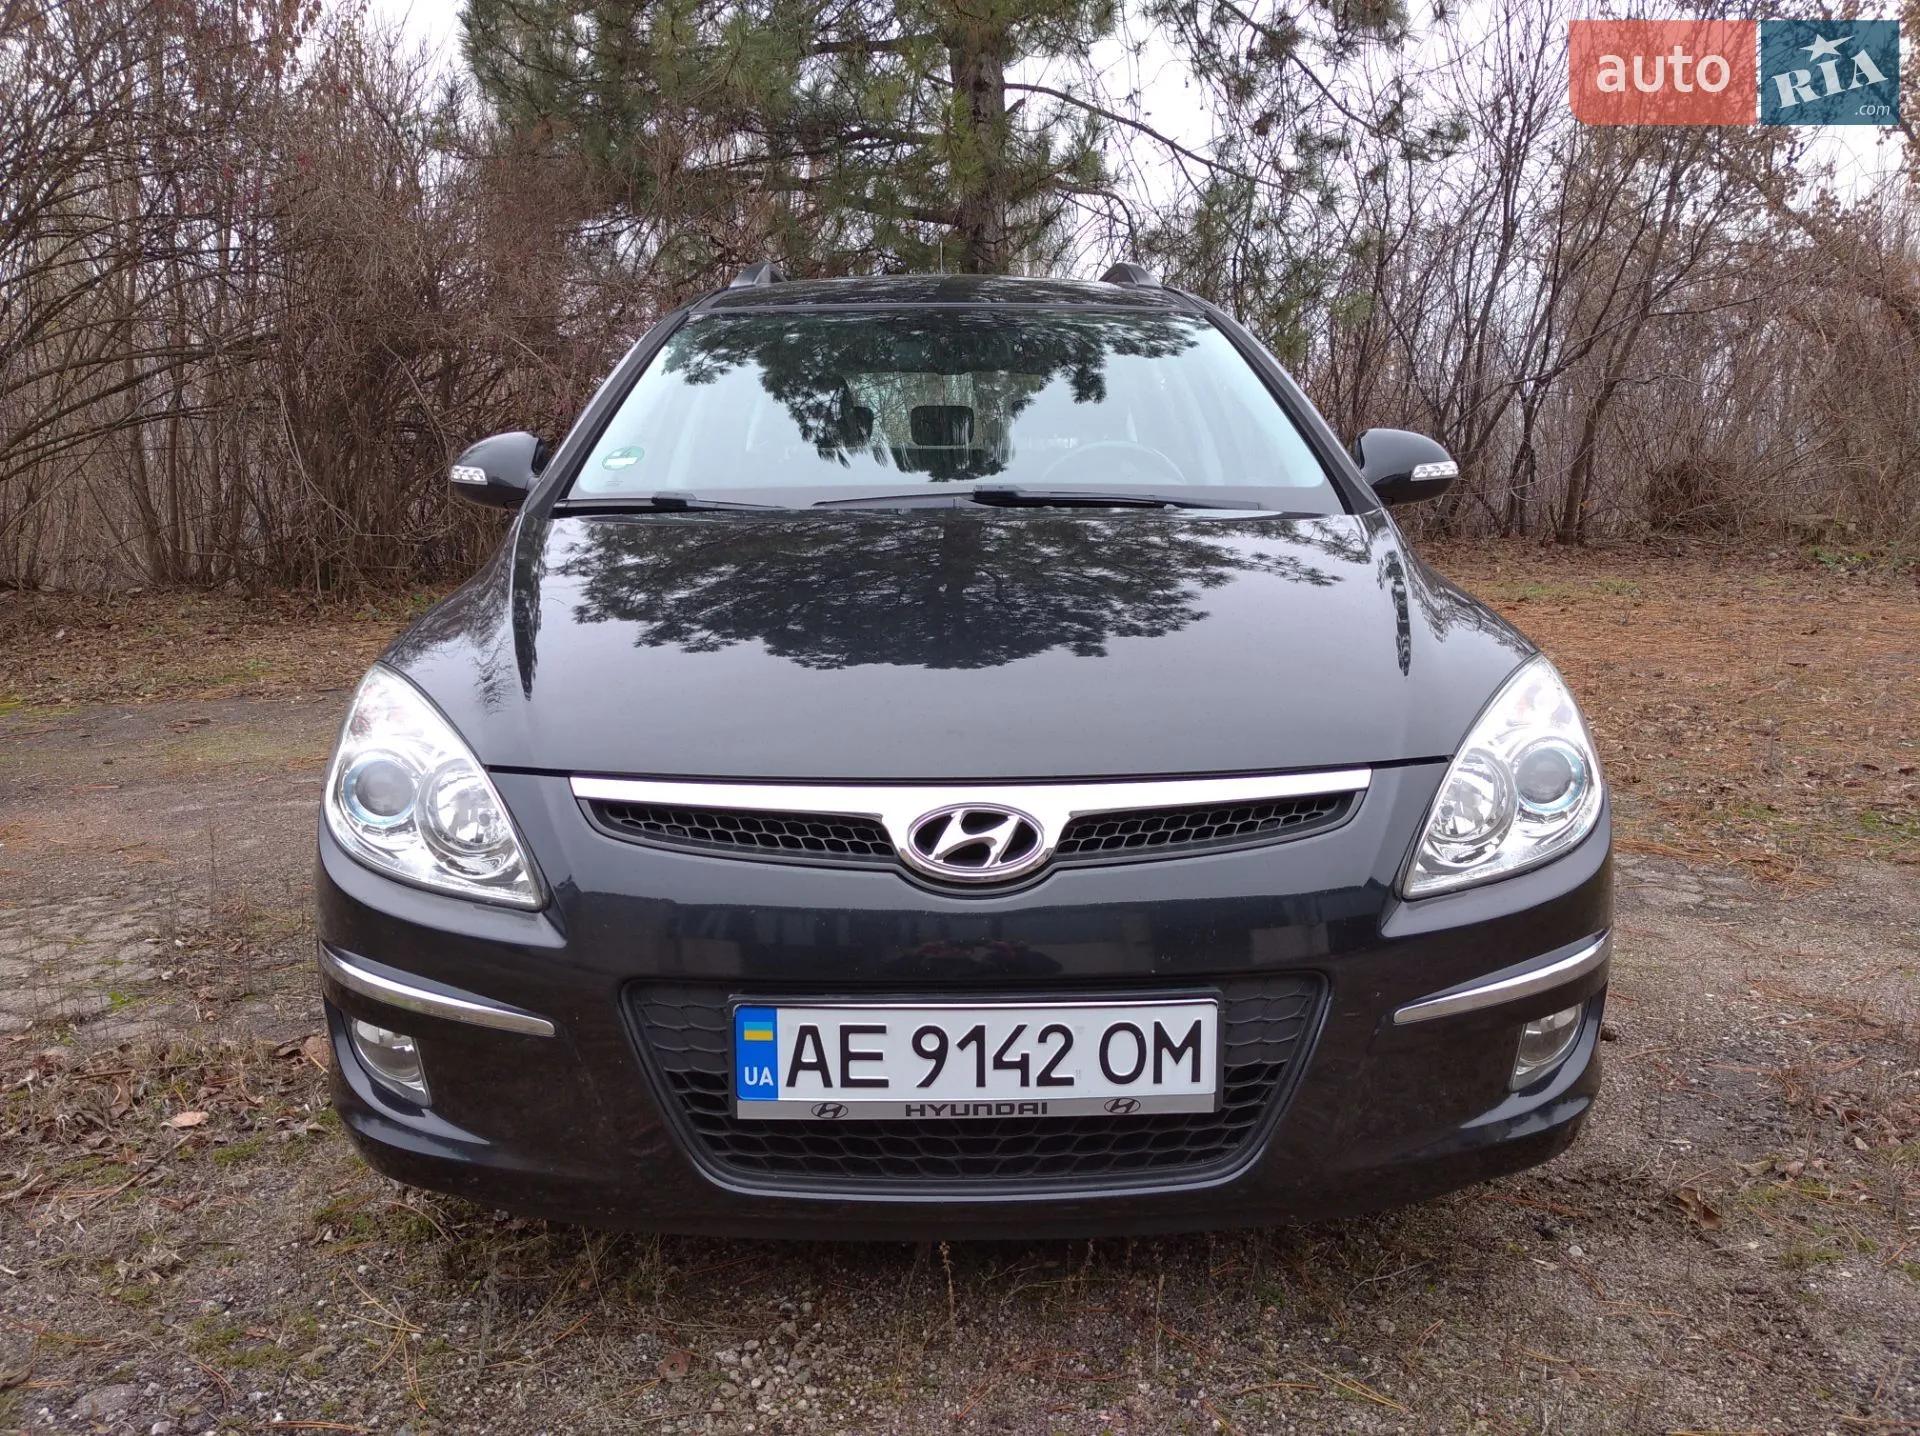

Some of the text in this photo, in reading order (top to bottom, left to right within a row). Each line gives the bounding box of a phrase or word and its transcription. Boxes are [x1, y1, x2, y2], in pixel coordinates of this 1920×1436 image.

[785, 1019, 1203, 1088] AE 9142 OM
[744, 1066, 774, 1087] UA
[905, 1102, 1048, 1117] HYUNDAI
